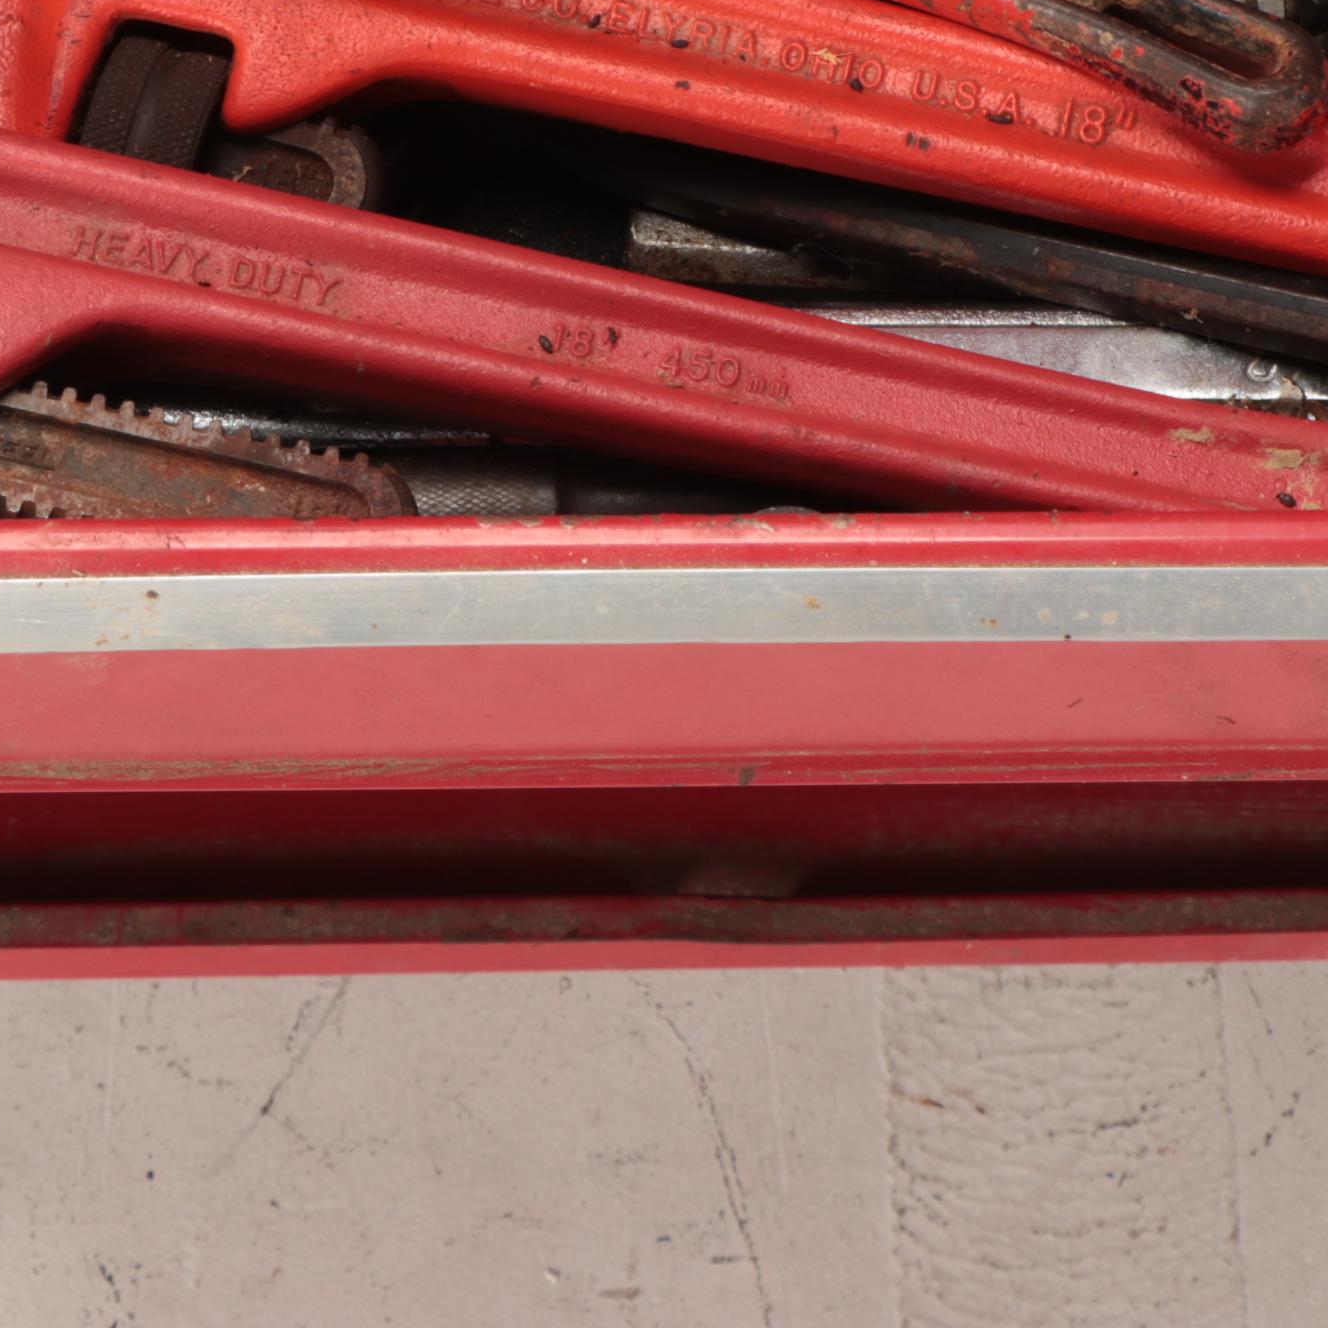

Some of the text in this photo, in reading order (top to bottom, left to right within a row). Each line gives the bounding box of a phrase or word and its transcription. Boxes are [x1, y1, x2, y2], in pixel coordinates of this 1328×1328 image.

[780, 41, 884, 89] OHIO
[911, 70, 1034, 125] U.S.A.
[71, 225, 343, 306] HEAVY DUTY
[657, 346, 741, 388] 450
